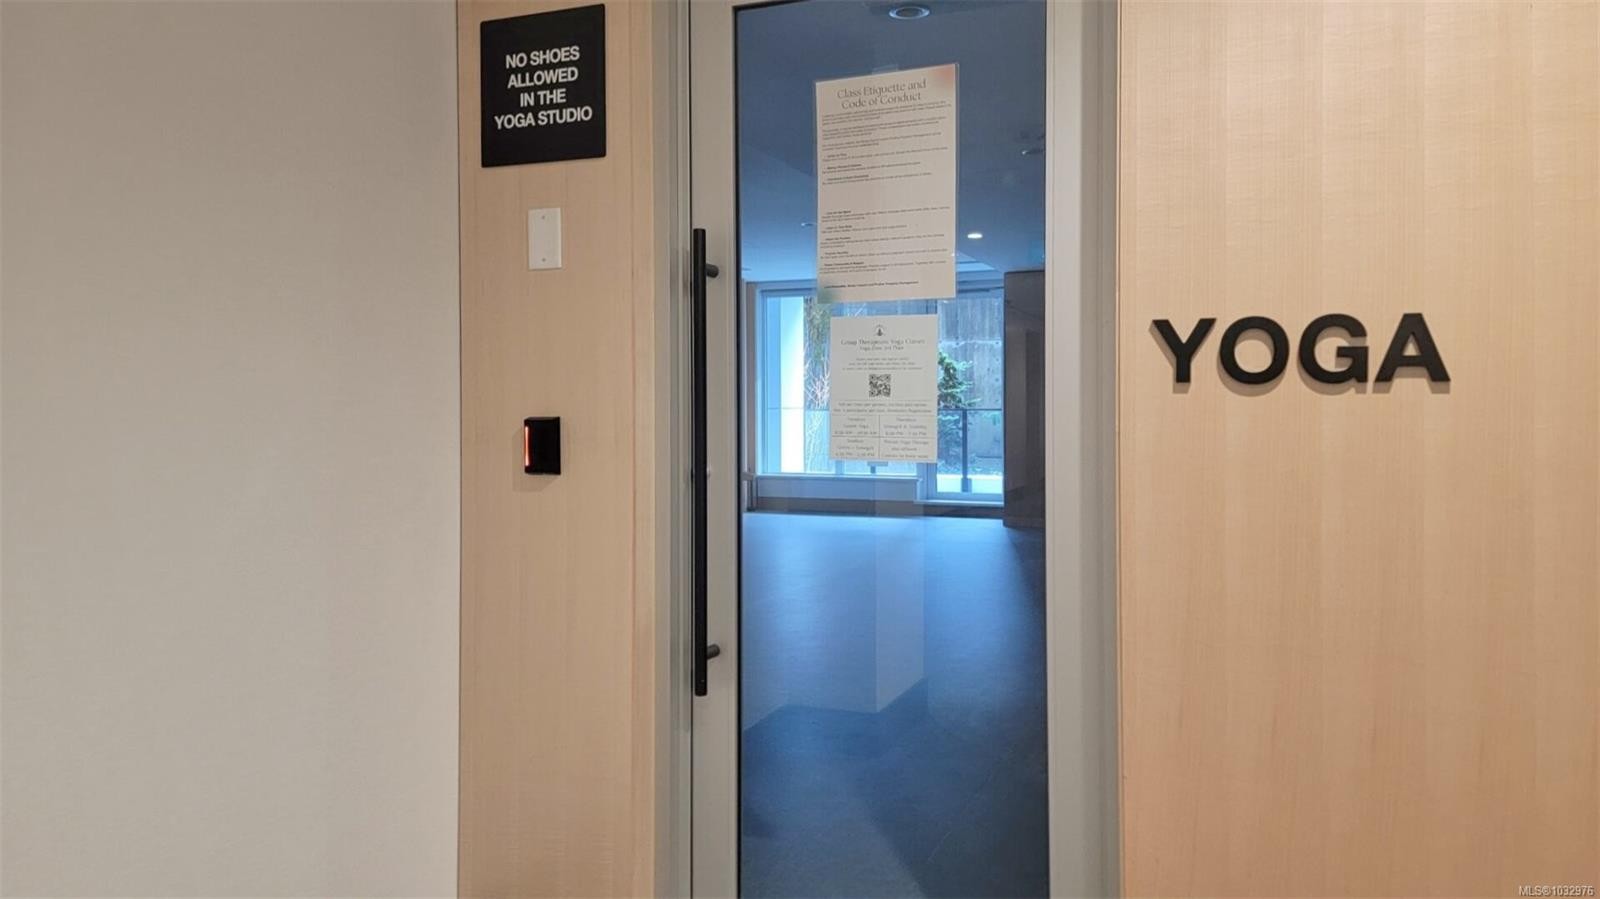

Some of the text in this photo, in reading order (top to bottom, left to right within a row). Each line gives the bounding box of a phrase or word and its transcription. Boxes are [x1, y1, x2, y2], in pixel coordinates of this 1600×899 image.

[505, 46, 580, 69] NO SHOES
[507, 67, 578, 89] ALLOWED
[837, 78, 927, 99] Class Etiquette and
[520, 88, 566, 107] IN THE
[841, 92, 921, 110] Code of Conduct
[494, 106, 593, 130] YOGA STUDIO
[1152, 312, 1452, 386] YOGA
